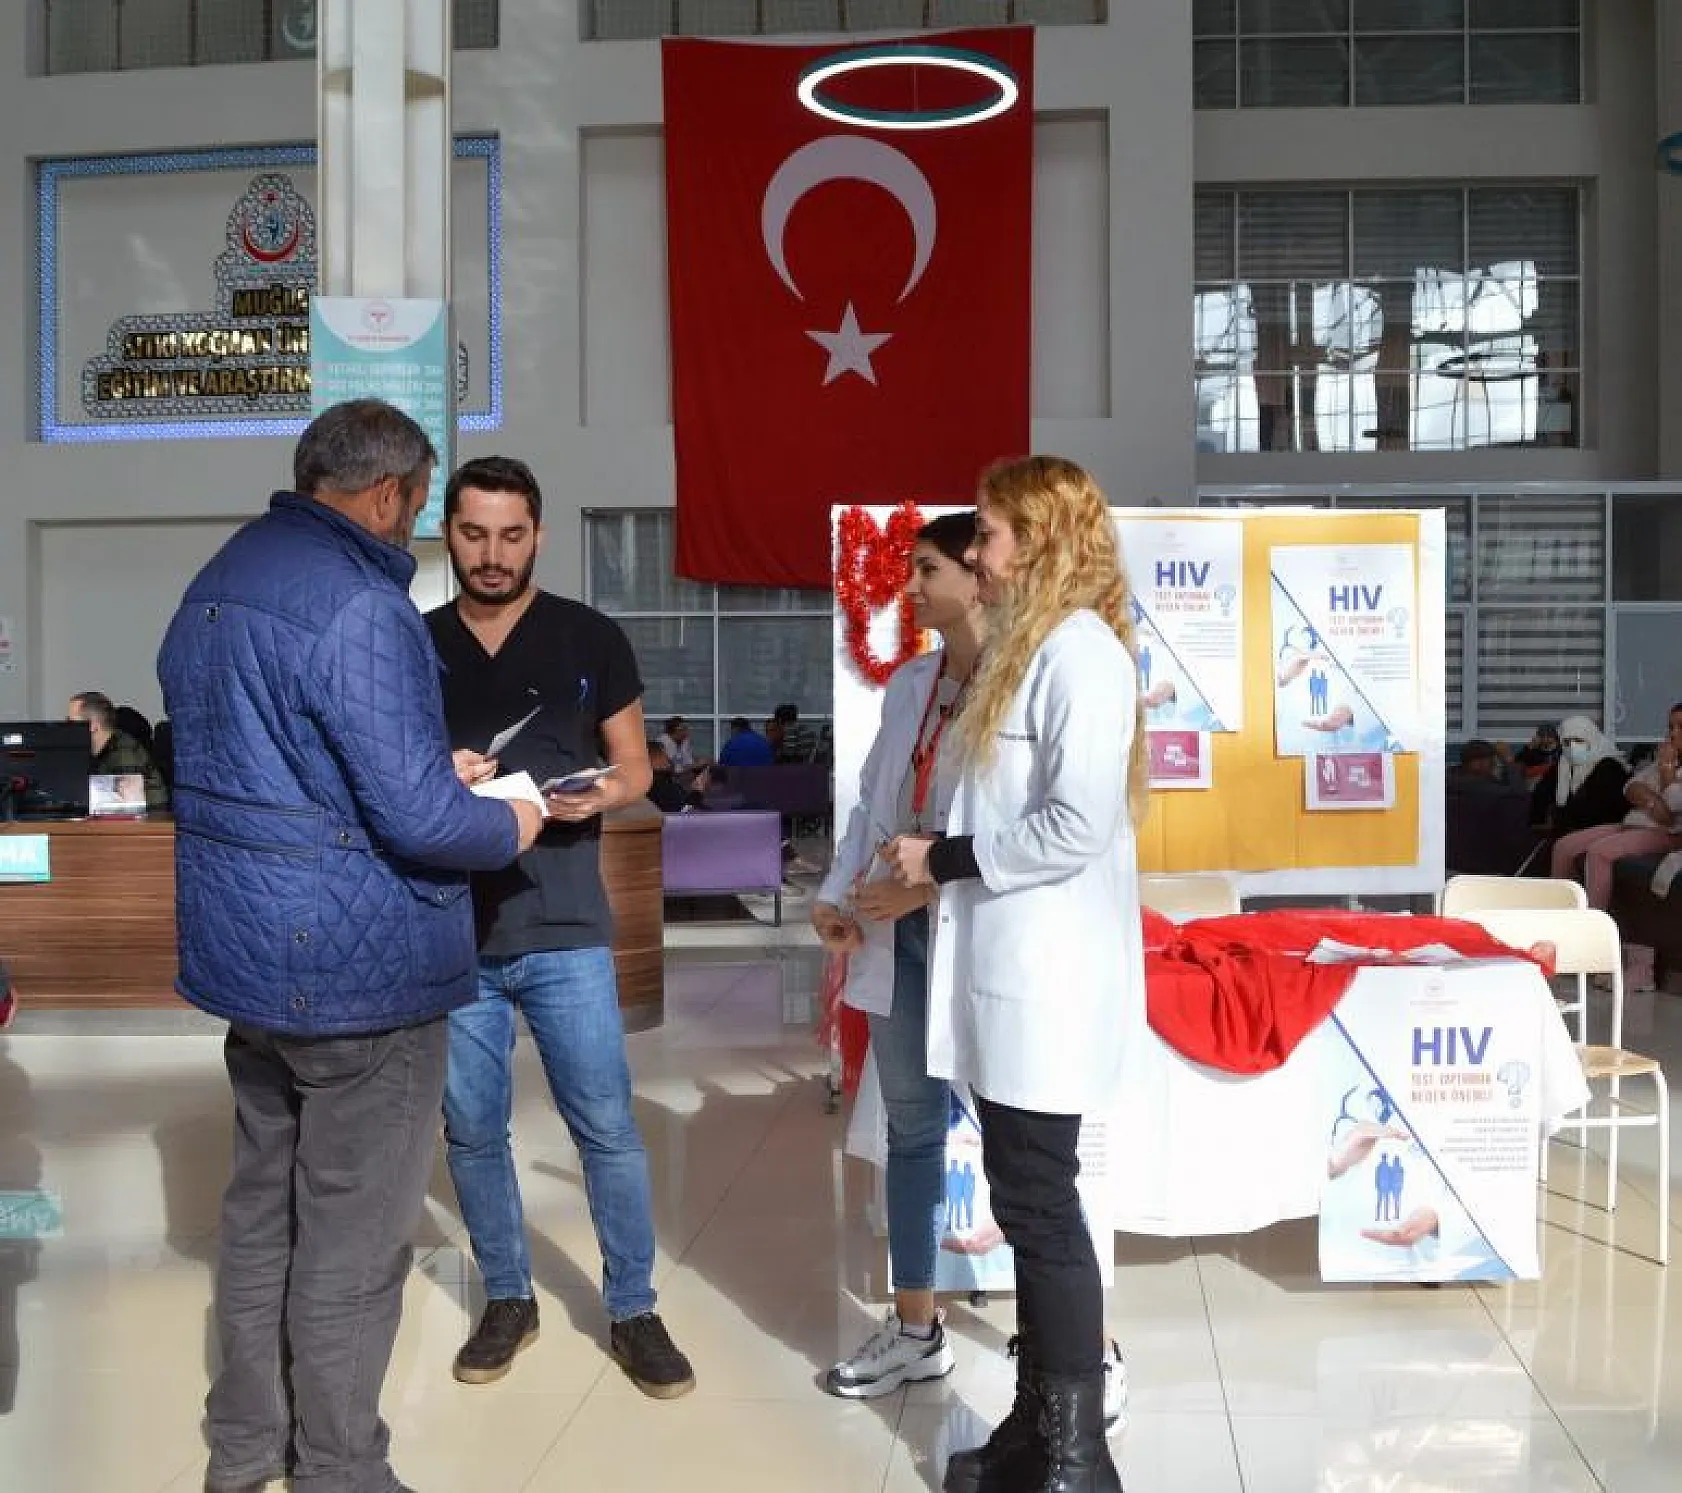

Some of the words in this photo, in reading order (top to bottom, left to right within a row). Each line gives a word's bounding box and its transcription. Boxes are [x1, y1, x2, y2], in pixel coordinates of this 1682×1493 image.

[180, 328, 272, 362] KOÇMAN
[98, 367, 172, 400] EĞİTİM
[173, 369, 200, 396] VE
[1155, 561, 1210, 588] HIV
[1329, 584, 1383, 611] HIV
[1412, 1027, 1493, 1066] HIV
